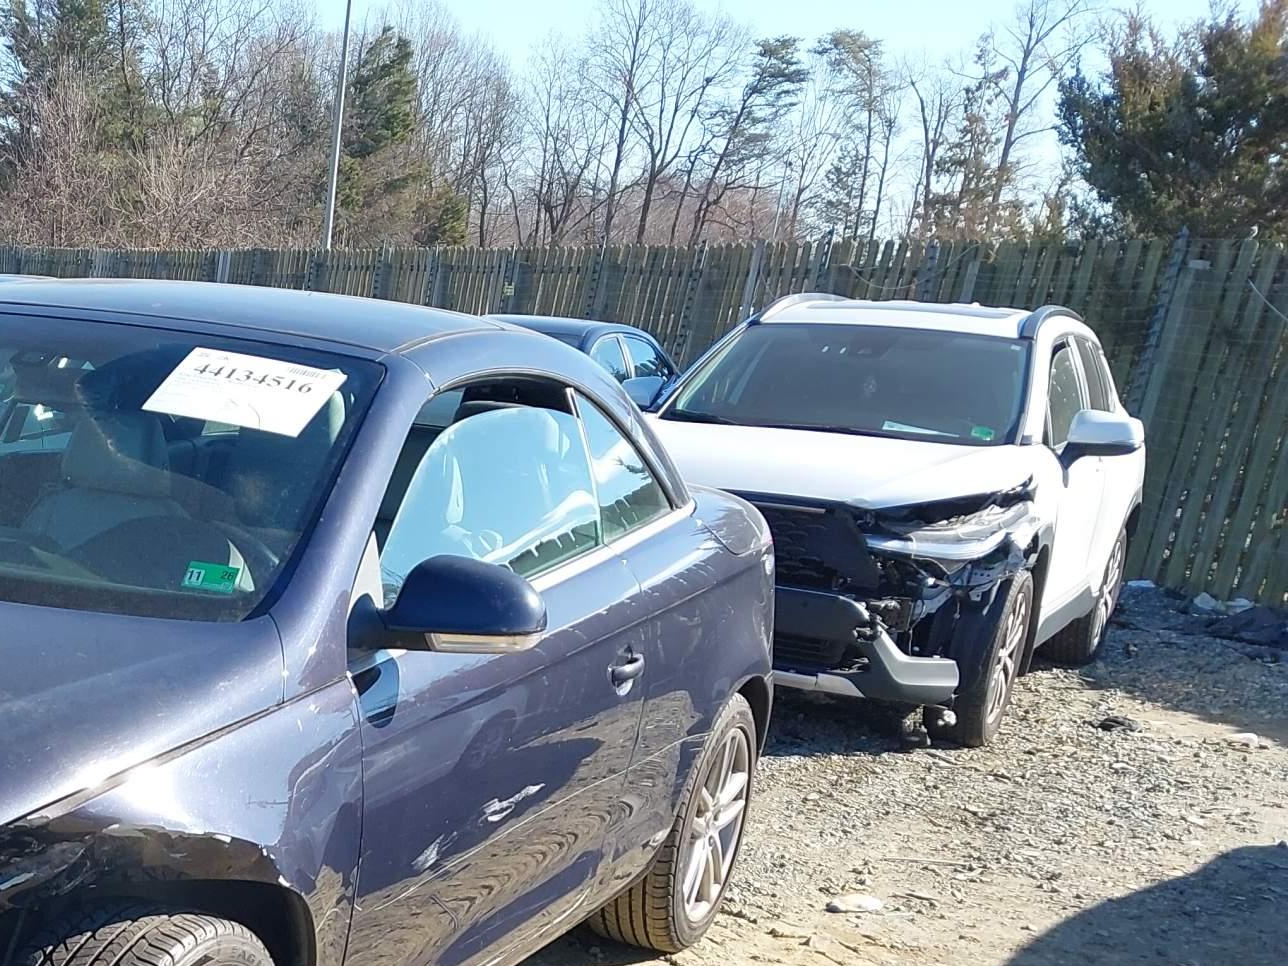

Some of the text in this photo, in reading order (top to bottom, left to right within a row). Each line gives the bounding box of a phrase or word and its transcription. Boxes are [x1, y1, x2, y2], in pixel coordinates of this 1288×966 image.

[193, 363, 313, 394] 44134516
[187, 570, 234, 581] 11 26
